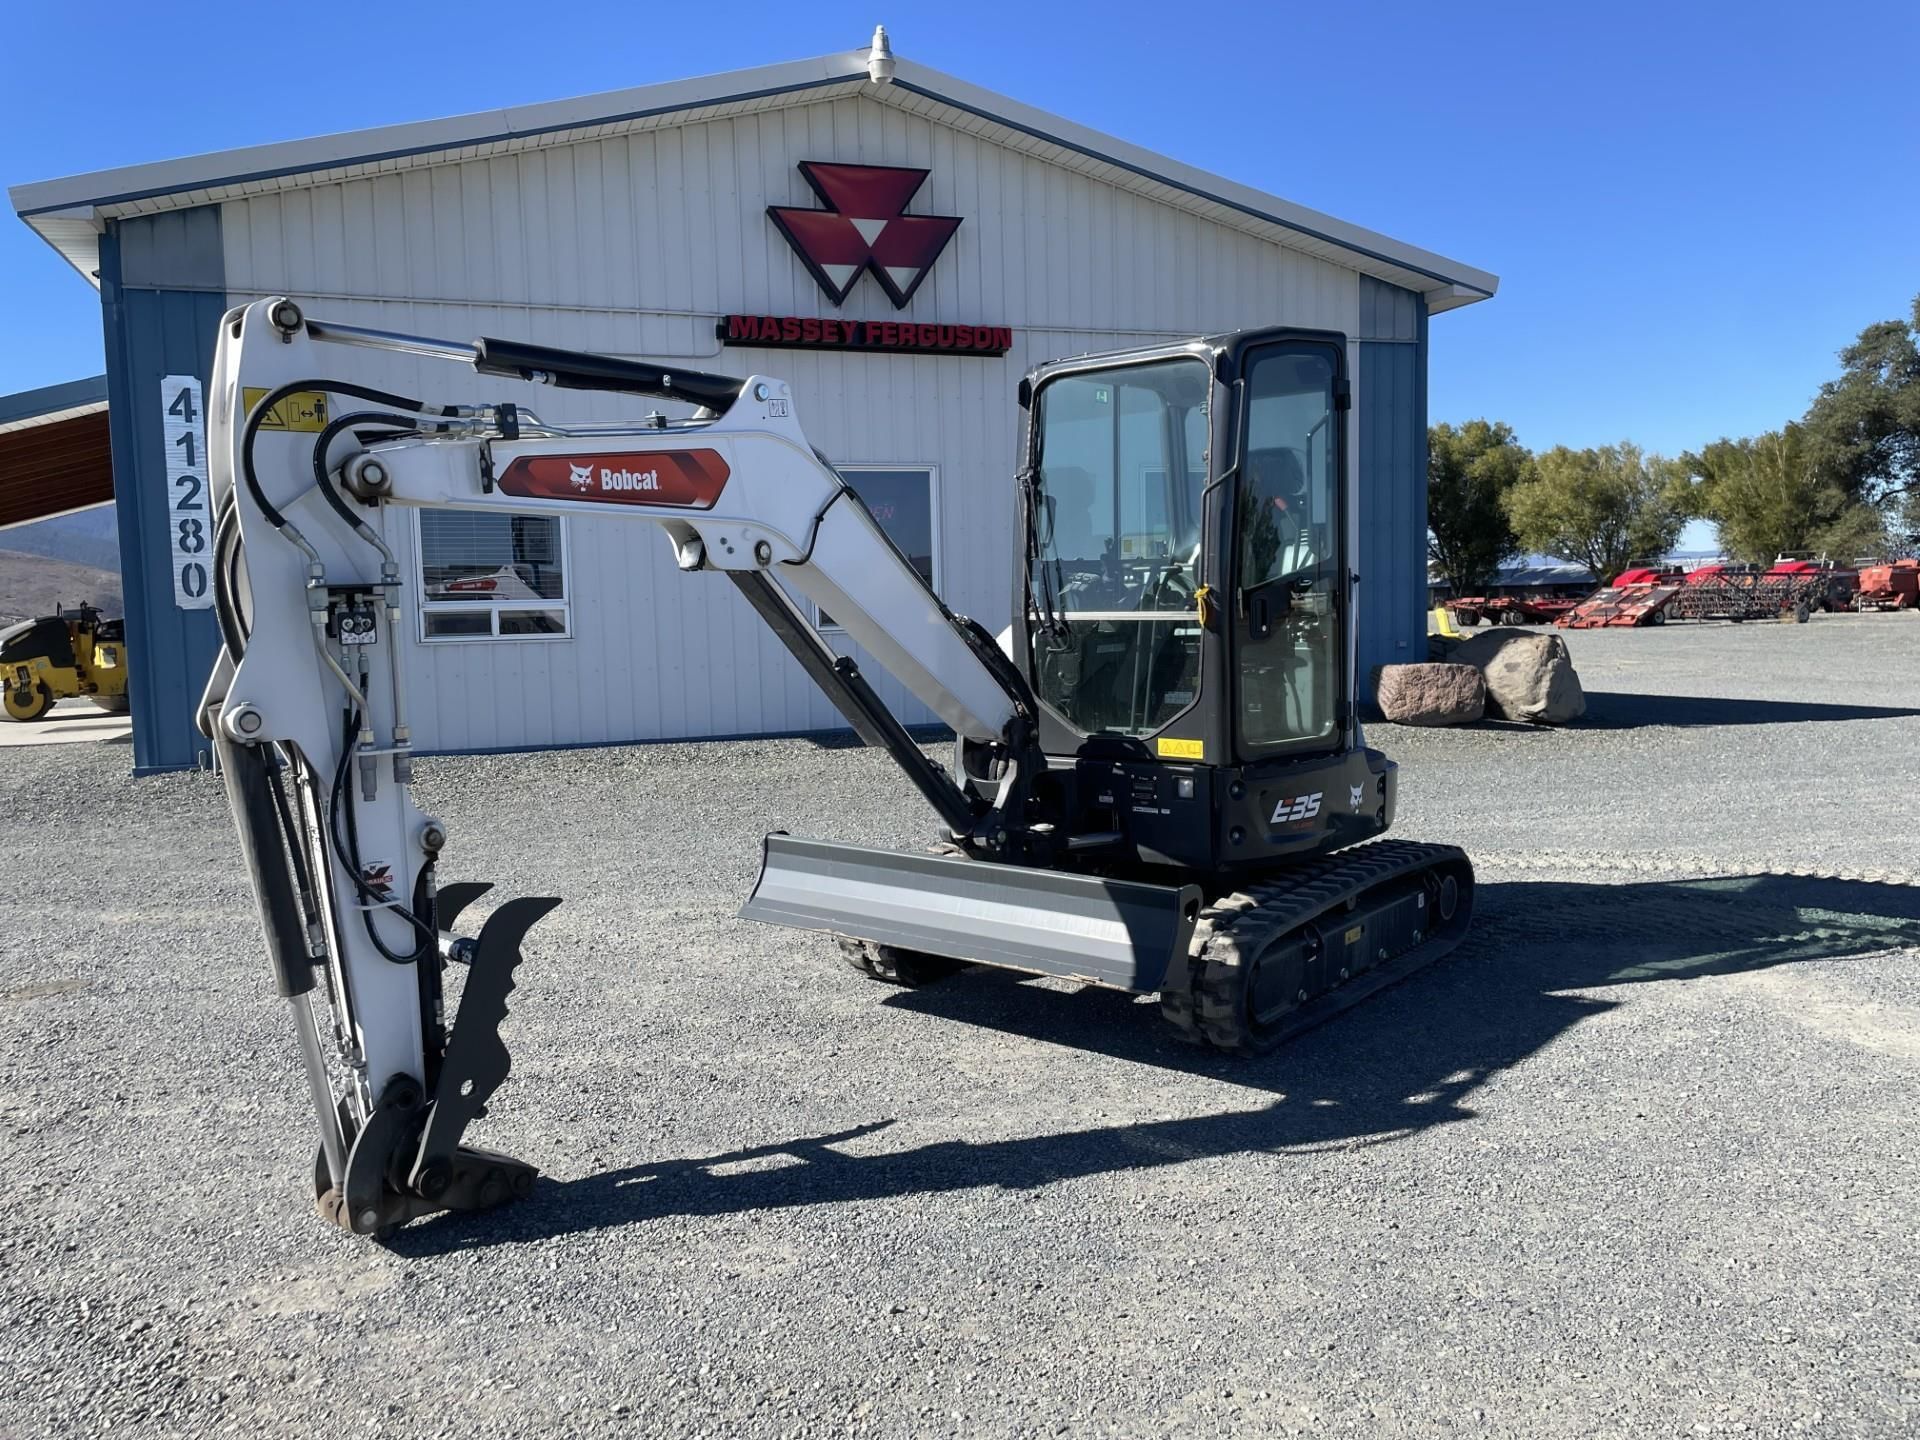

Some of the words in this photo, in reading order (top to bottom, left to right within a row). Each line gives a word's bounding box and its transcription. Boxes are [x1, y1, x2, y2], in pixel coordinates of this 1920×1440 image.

[730, 315, 858, 344] MASSEY
[863, 320, 1012, 350] FERGUSON
[168, 387, 208, 598] 41280
[600, 468, 659, 490] Bobcat
[1270, 791, 1323, 823] E35
